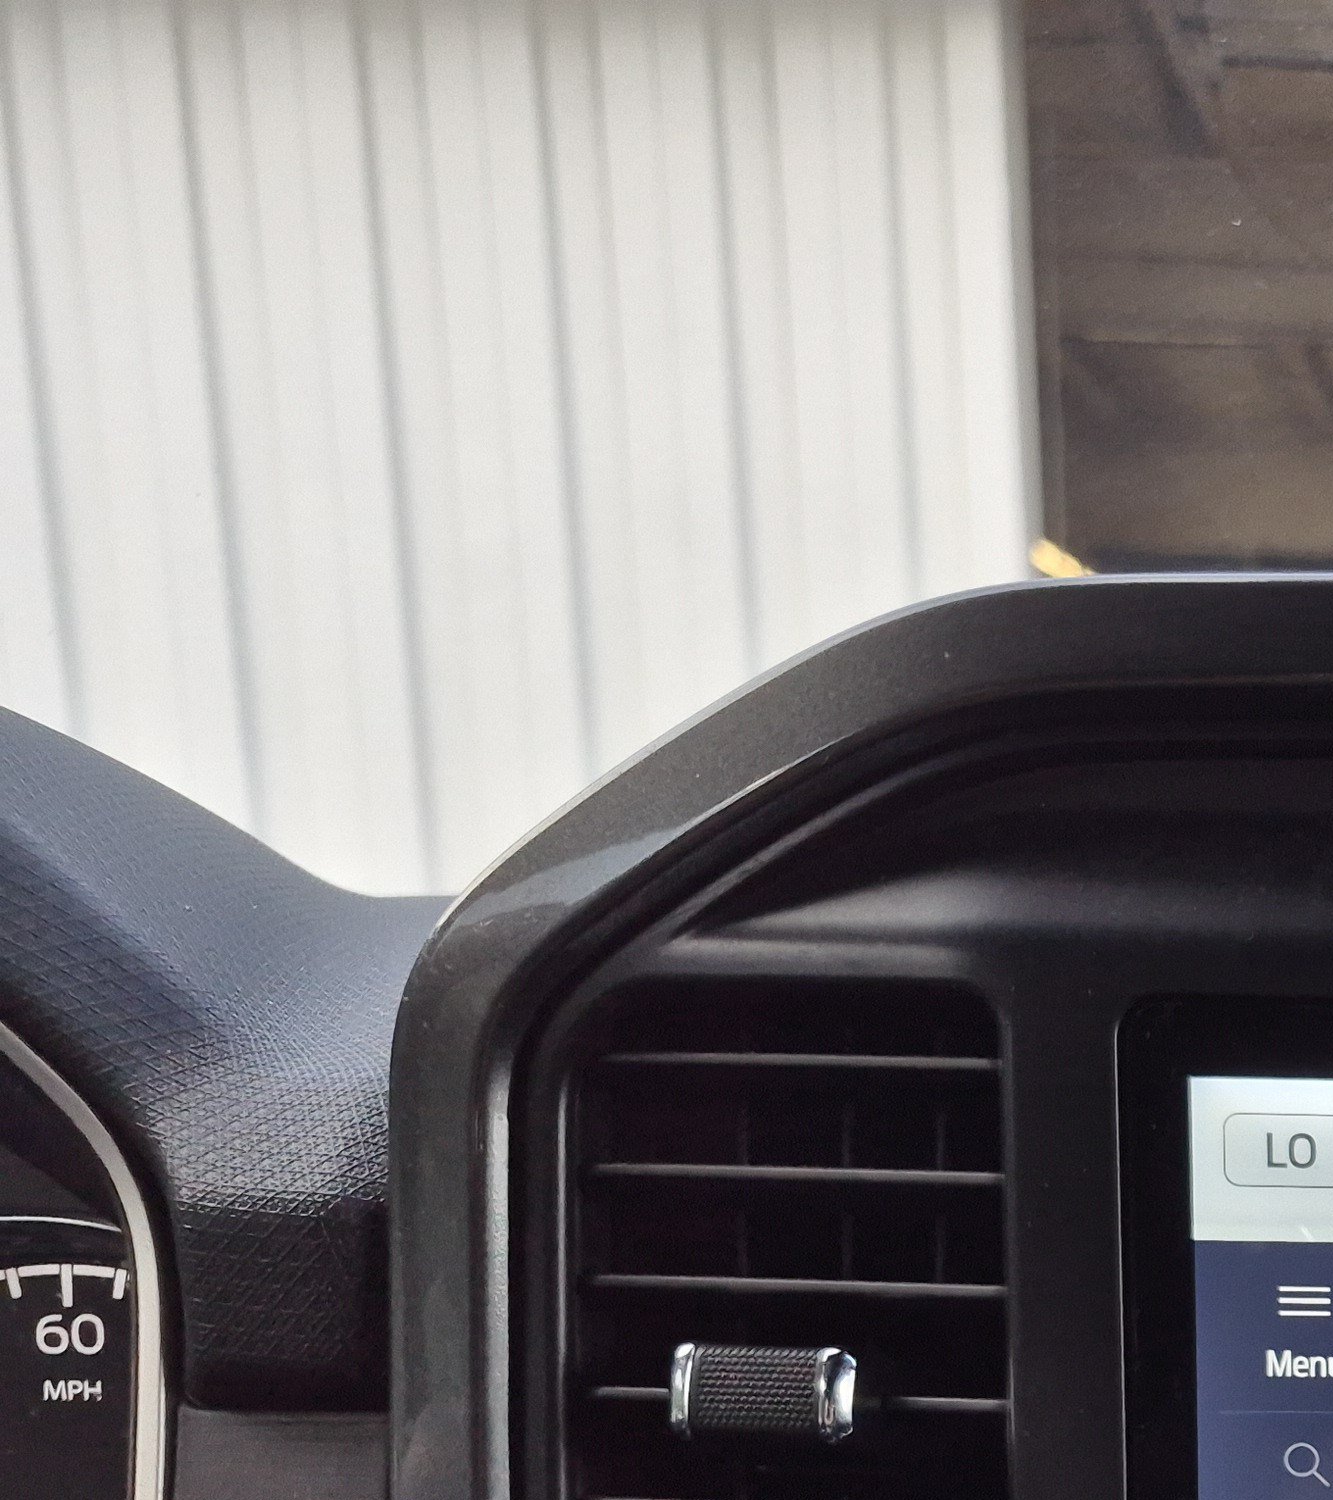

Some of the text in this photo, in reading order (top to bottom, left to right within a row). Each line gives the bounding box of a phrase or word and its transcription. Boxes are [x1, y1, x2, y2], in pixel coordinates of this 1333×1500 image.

[1266, 1133, 1316, 1169] LO
[35, 1313, 105, 1355] 60
[42, 1378, 103, 1402] MPH
